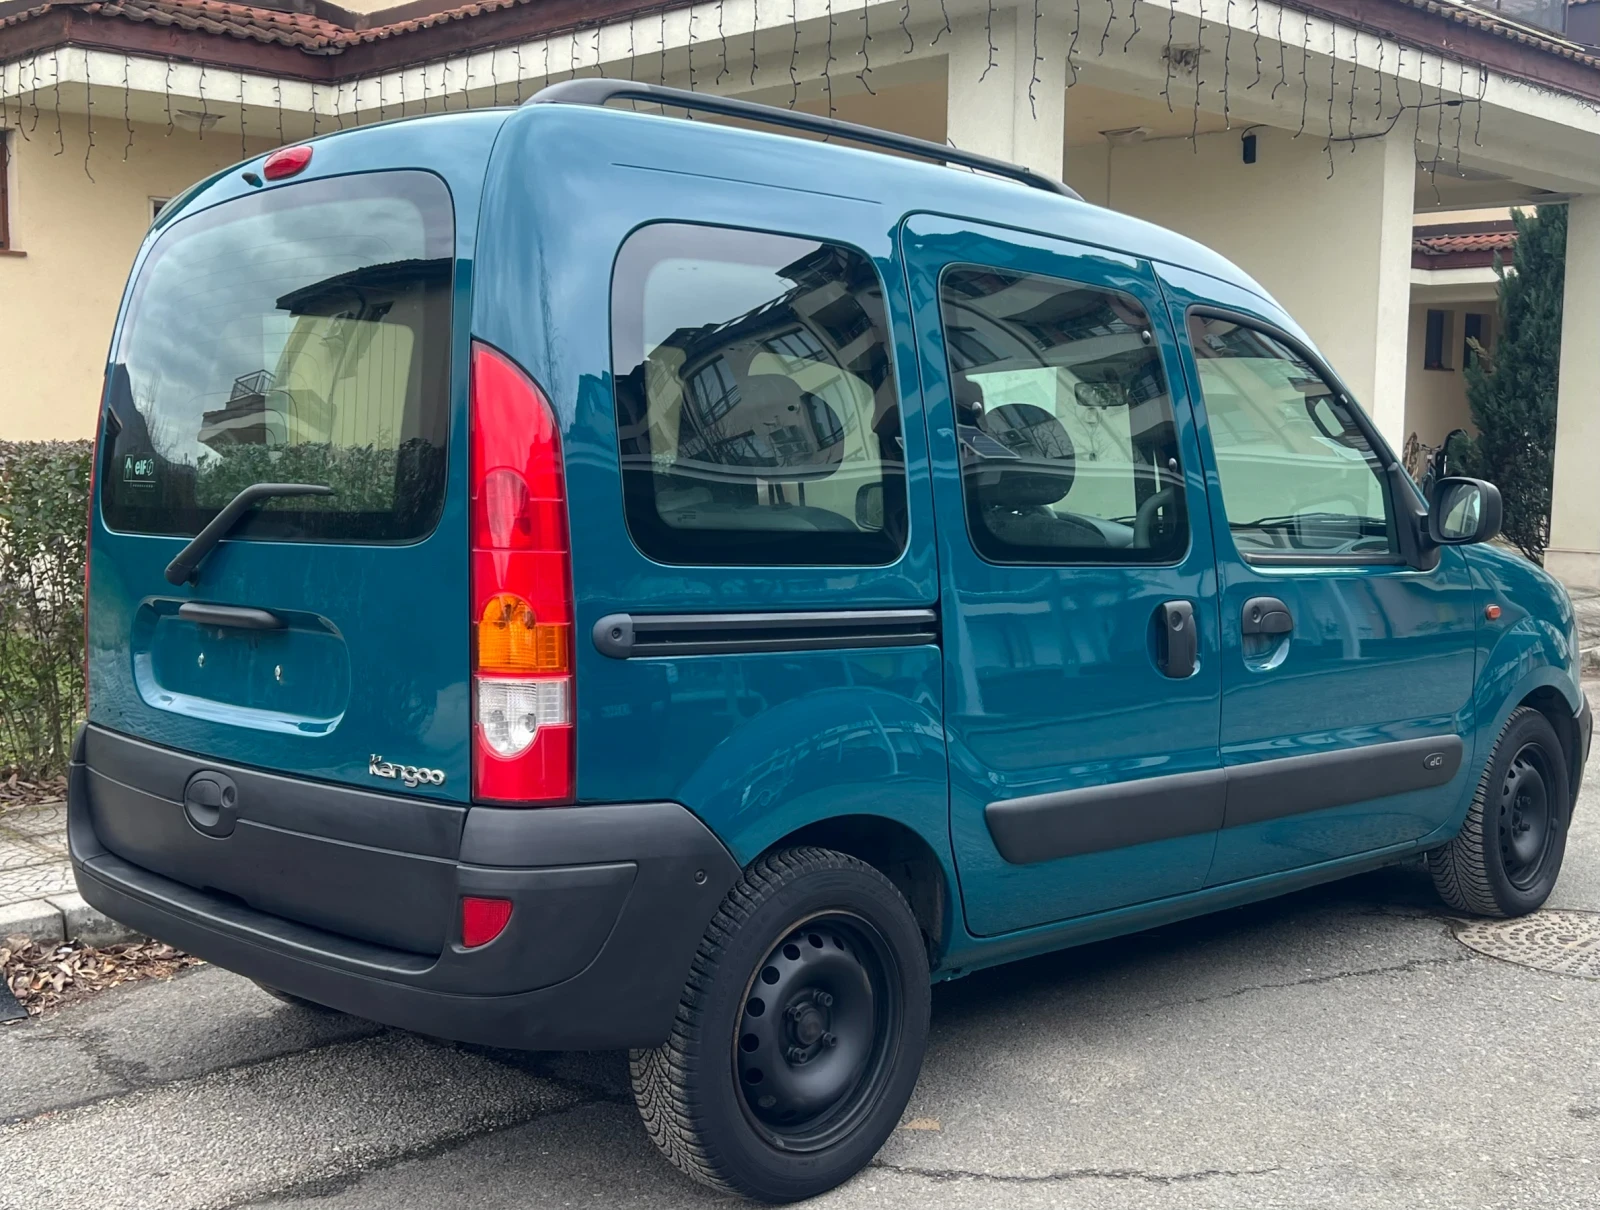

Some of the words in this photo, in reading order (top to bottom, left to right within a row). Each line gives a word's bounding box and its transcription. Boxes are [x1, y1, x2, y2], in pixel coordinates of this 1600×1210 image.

[134, 459, 147, 476] elf
[1430, 756, 1443, 767] dCi
[368, 753, 445, 788] Kangoo
